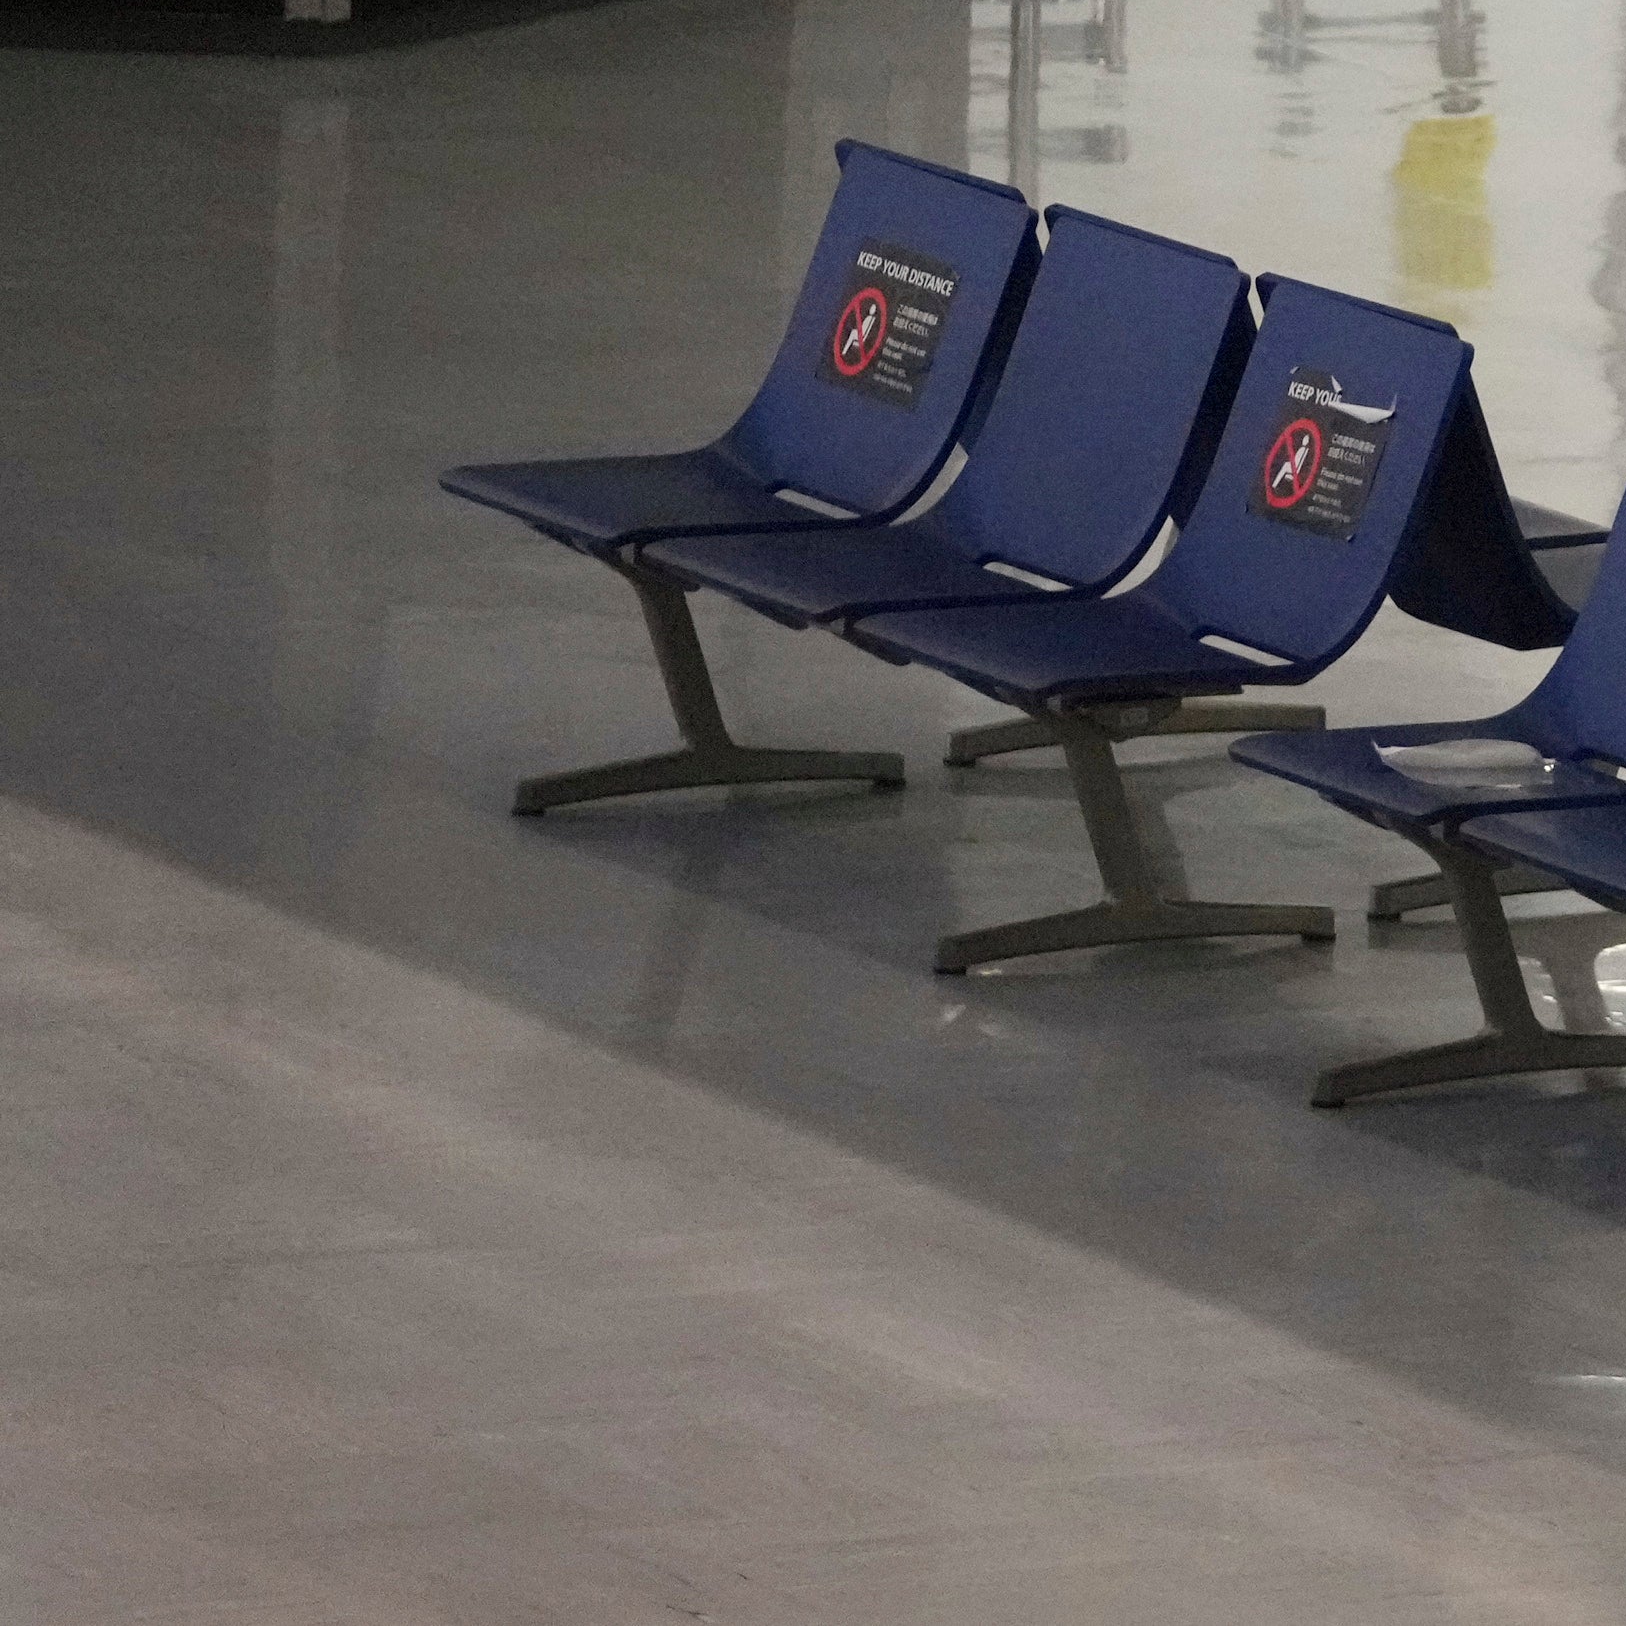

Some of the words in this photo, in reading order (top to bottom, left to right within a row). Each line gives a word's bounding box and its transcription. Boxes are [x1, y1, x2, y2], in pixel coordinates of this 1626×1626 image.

[857, 251, 883, 271] KEEP
[882, 259, 910, 281] YOUR
[909, 269, 954, 296] DISTANCE
[1288, 381, 1315, 401] KEEP
